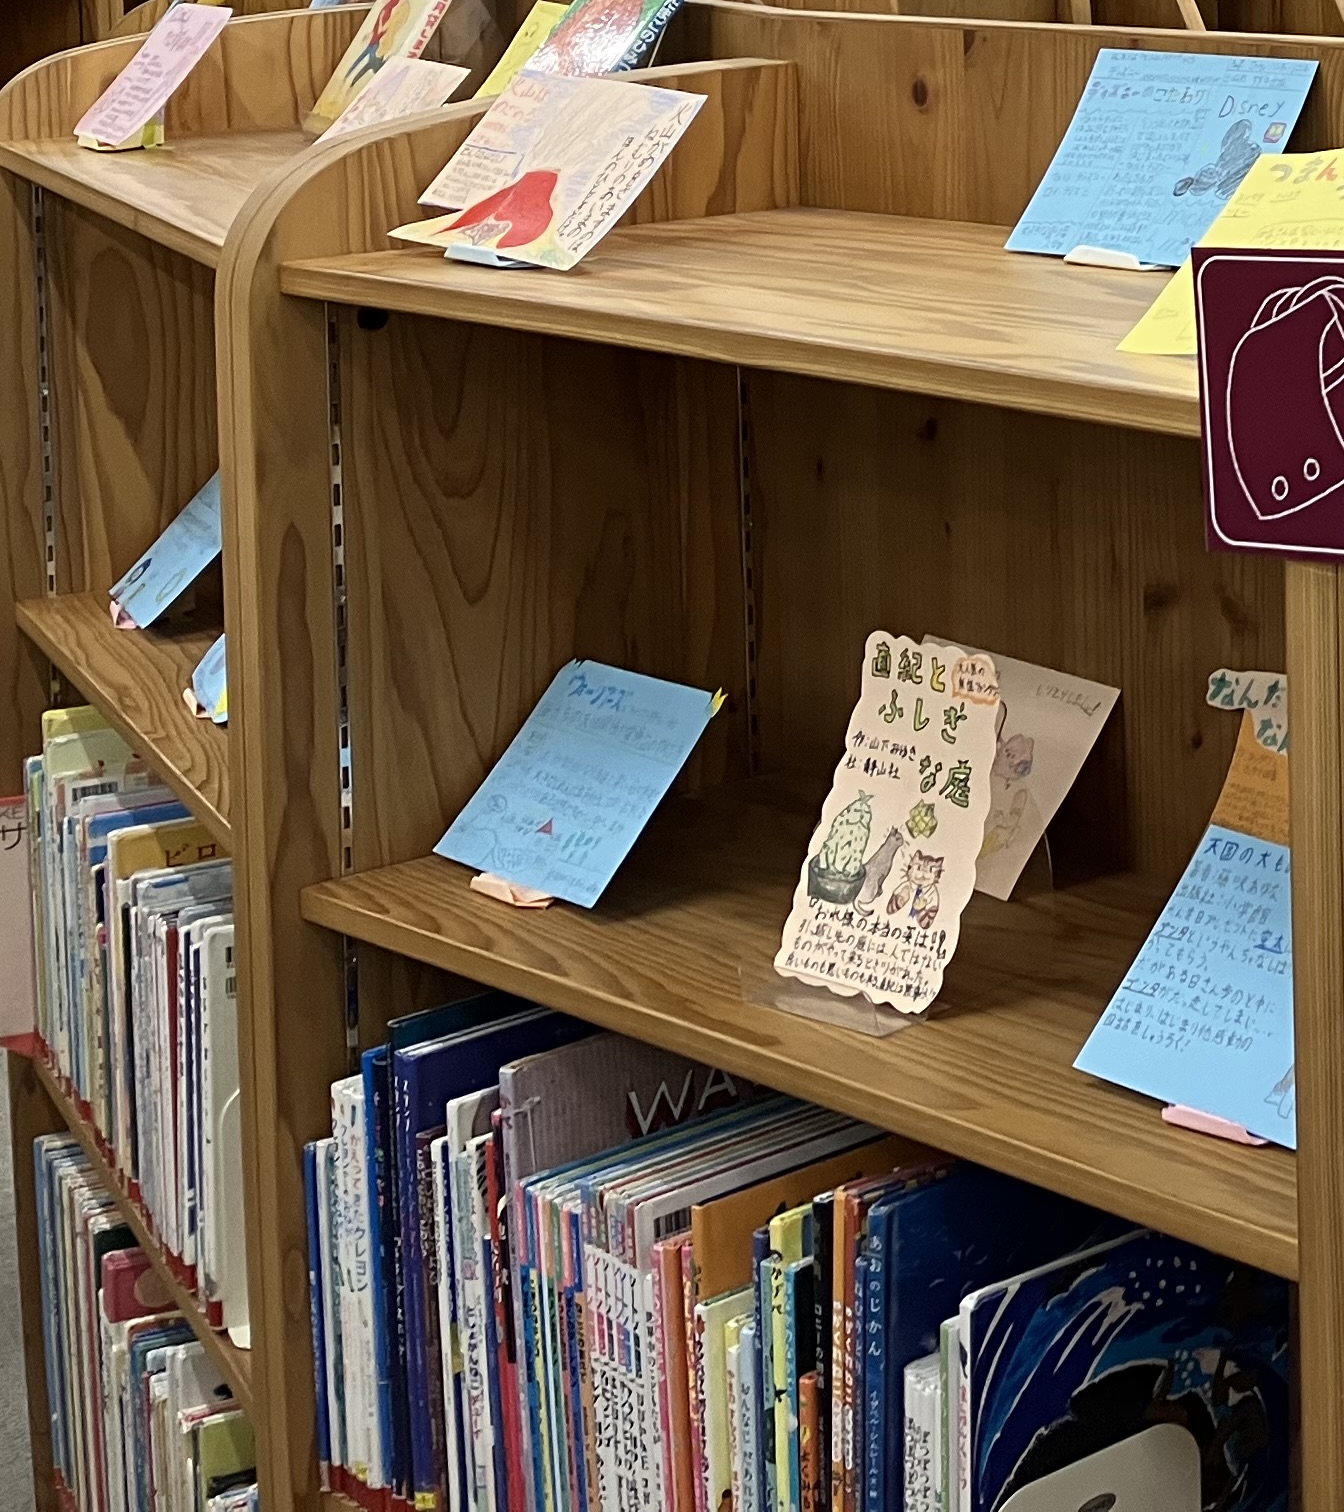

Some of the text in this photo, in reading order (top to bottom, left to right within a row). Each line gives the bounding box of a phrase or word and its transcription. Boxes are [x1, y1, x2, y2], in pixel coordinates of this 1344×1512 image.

[1218, 94, 1286, 119] Disney
[871, 640, 946, 694] 直紀と
[877, 688, 968, 745] ふしぎ
[918, 755, 973, 809] な庭
[866, 1234, 883, 1357] あおのじかん
